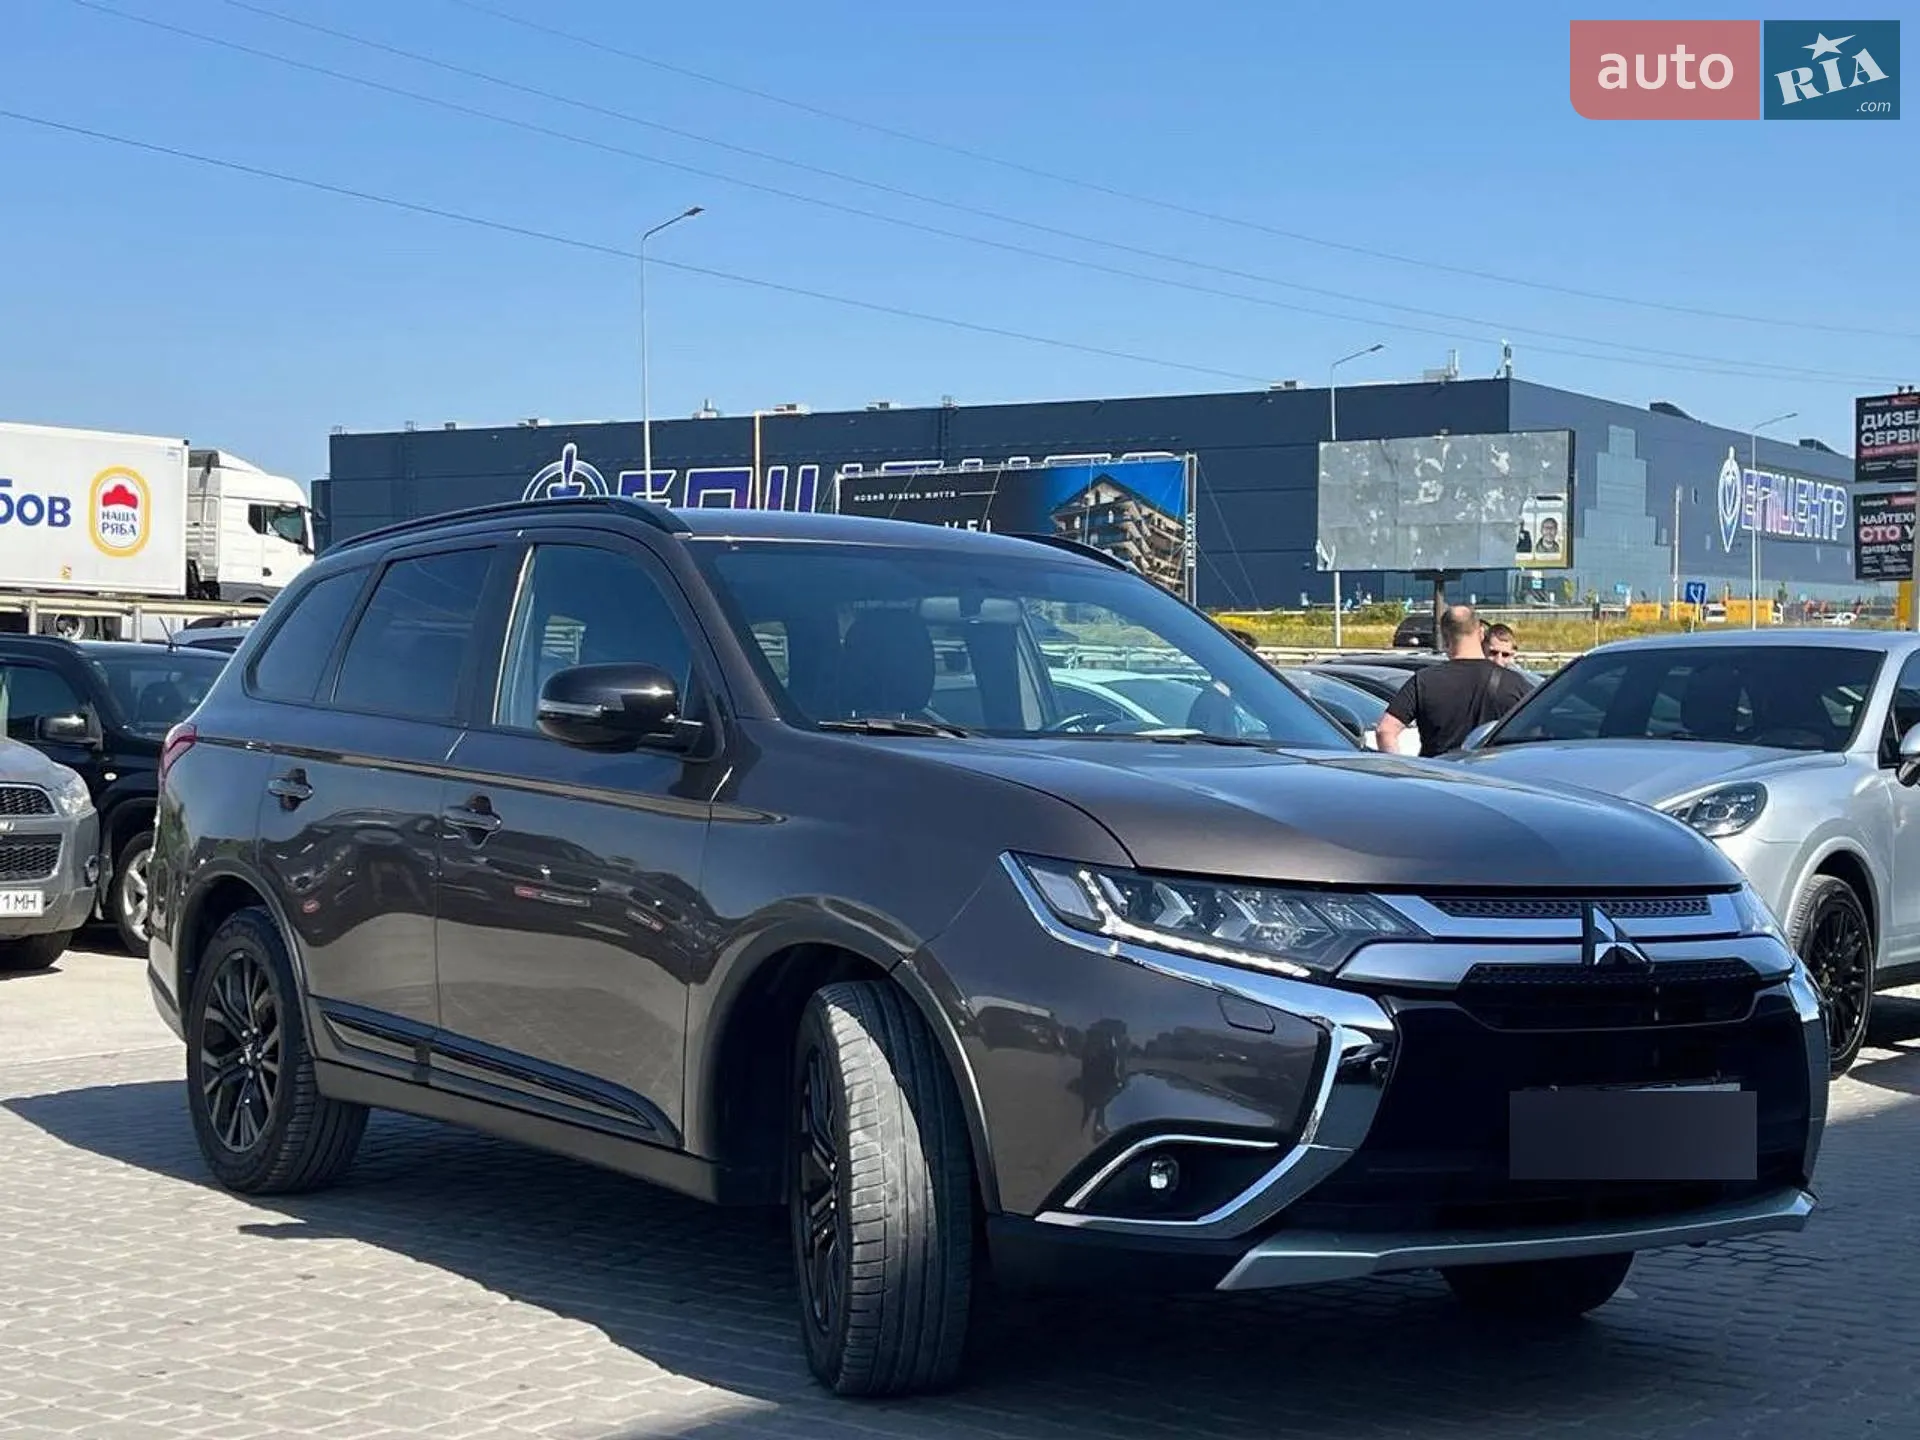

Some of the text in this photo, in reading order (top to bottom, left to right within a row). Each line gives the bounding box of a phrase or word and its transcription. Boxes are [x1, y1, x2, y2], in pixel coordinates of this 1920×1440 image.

[1861, 409, 1920, 431] ДИЗЕ
[102, 510, 137, 522] НАША
[102, 522, 137, 536] РЯБА
[1860, 525, 1901, 542] СТО
